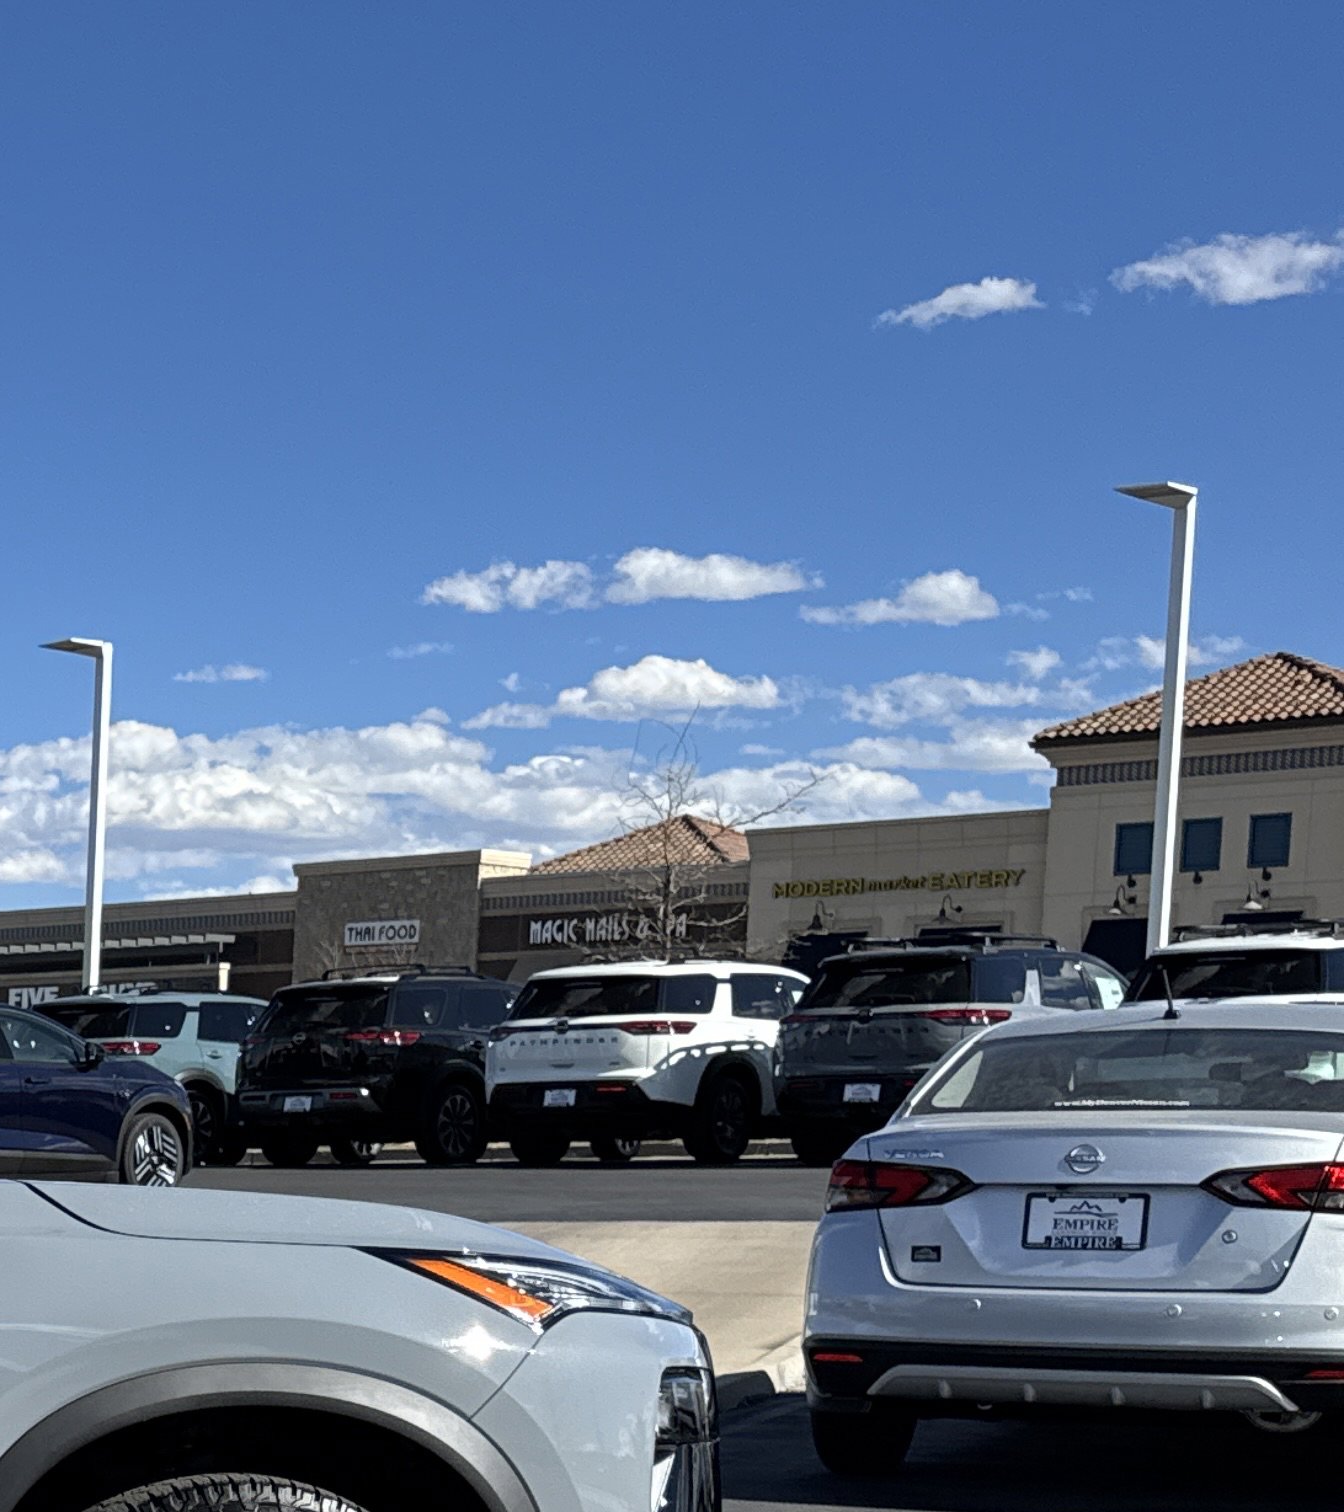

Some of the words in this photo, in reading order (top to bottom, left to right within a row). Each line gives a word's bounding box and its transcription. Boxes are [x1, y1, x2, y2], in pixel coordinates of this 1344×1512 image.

[772, 878, 864, 899] MODERN
[868, 875, 927, 892] market
[928, 868, 1026, 892] EATERY
[347, 926, 375, 942] THAI
[378, 924, 417, 941] FOOD
[529, 918, 578, 945] MAGIC
[585, 912, 629, 942] NAILS
[8, 986, 59, 1009] FIVE
[1052, 1217, 1119, 1231] EMPIRE
[1052, 1236, 1117, 1249] EMPIRE
